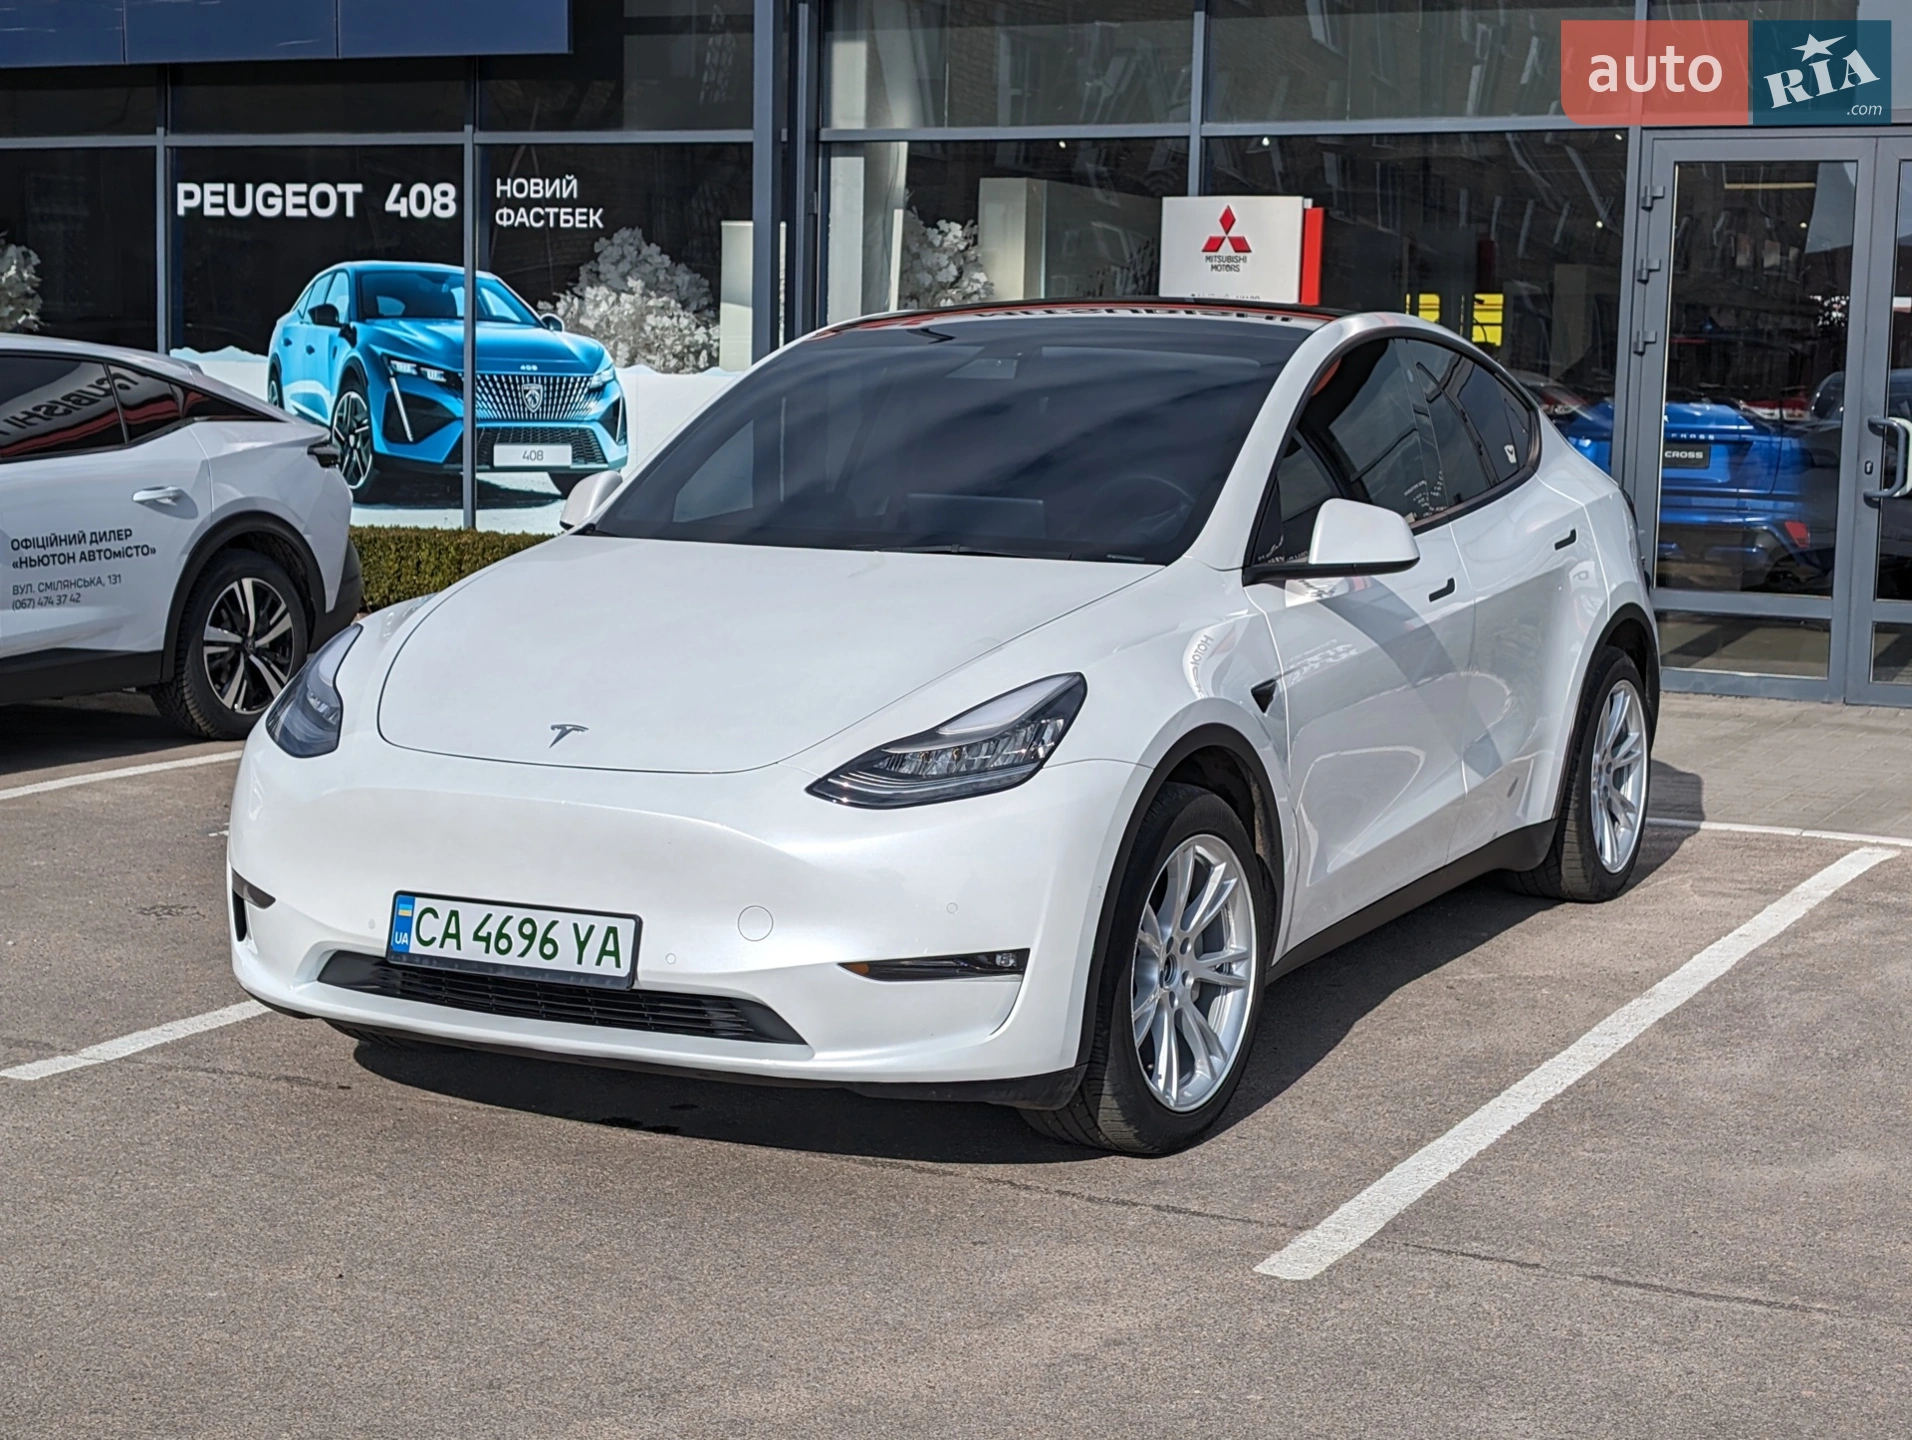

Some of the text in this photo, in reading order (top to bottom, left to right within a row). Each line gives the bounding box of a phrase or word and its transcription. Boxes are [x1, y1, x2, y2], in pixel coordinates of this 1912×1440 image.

[495, 174, 578, 199] НОВИЙ
[177, 182, 457, 218] PEUGEOT 408
[494, 207, 604, 229] ФАСТБЕК
[1204, 255, 1248, 264] MITSUBISHI
[1210, 264, 1241, 273] MOTORS
[522, 450, 544, 461] 408
[1664, 450, 1704, 459] CROSS
[11, 528, 133, 551] ОФІЦІЙНИЙ ДИЛЕР
[12, 552, 76, 569] «НЬЮТОН
[12, 574, 122, 596] ВУЛ. СМІЛЯНСЬКА, 131
[12, 593, 82, 612] (067) 474 37 42
[394, 932, 409, 946] UA
[415, 907, 622, 969] CA 4696 YA
